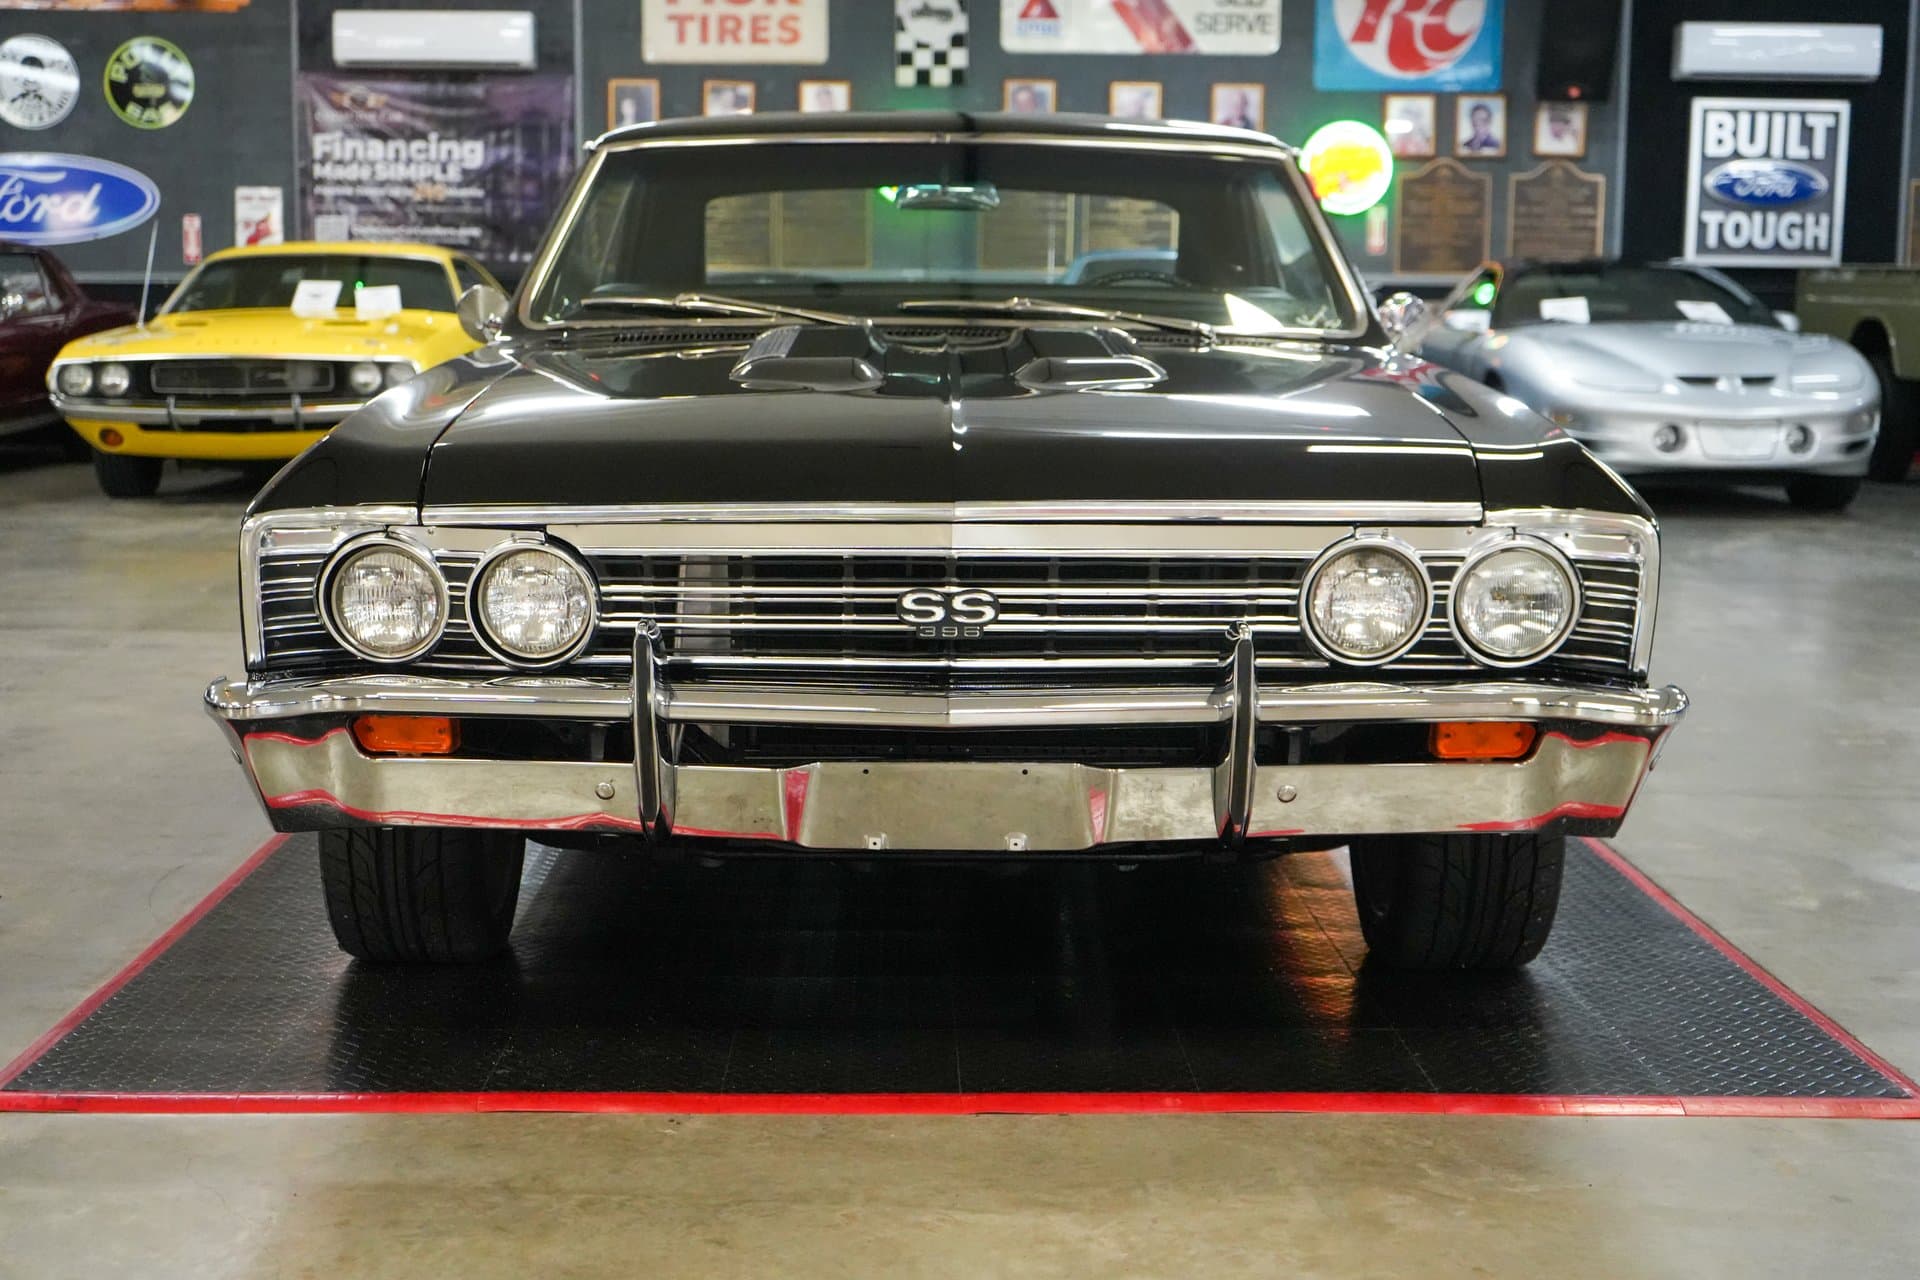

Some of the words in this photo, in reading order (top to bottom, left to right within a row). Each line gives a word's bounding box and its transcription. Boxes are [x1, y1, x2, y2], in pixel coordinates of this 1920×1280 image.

[667, 14, 802, 45] TIRES
[1195, 13, 1272, 35] SERVE
[313, 131, 485, 170] Financing
[1704, 110, 1836, 160] BUILT
[375, 163, 463, 182] SIMPLE
[1733, 170, 1798, 199] Ford
[1701, 211, 1830, 250] TOUGH
[901, 592, 996, 624] SS
[919, 626, 981, 638] 396
